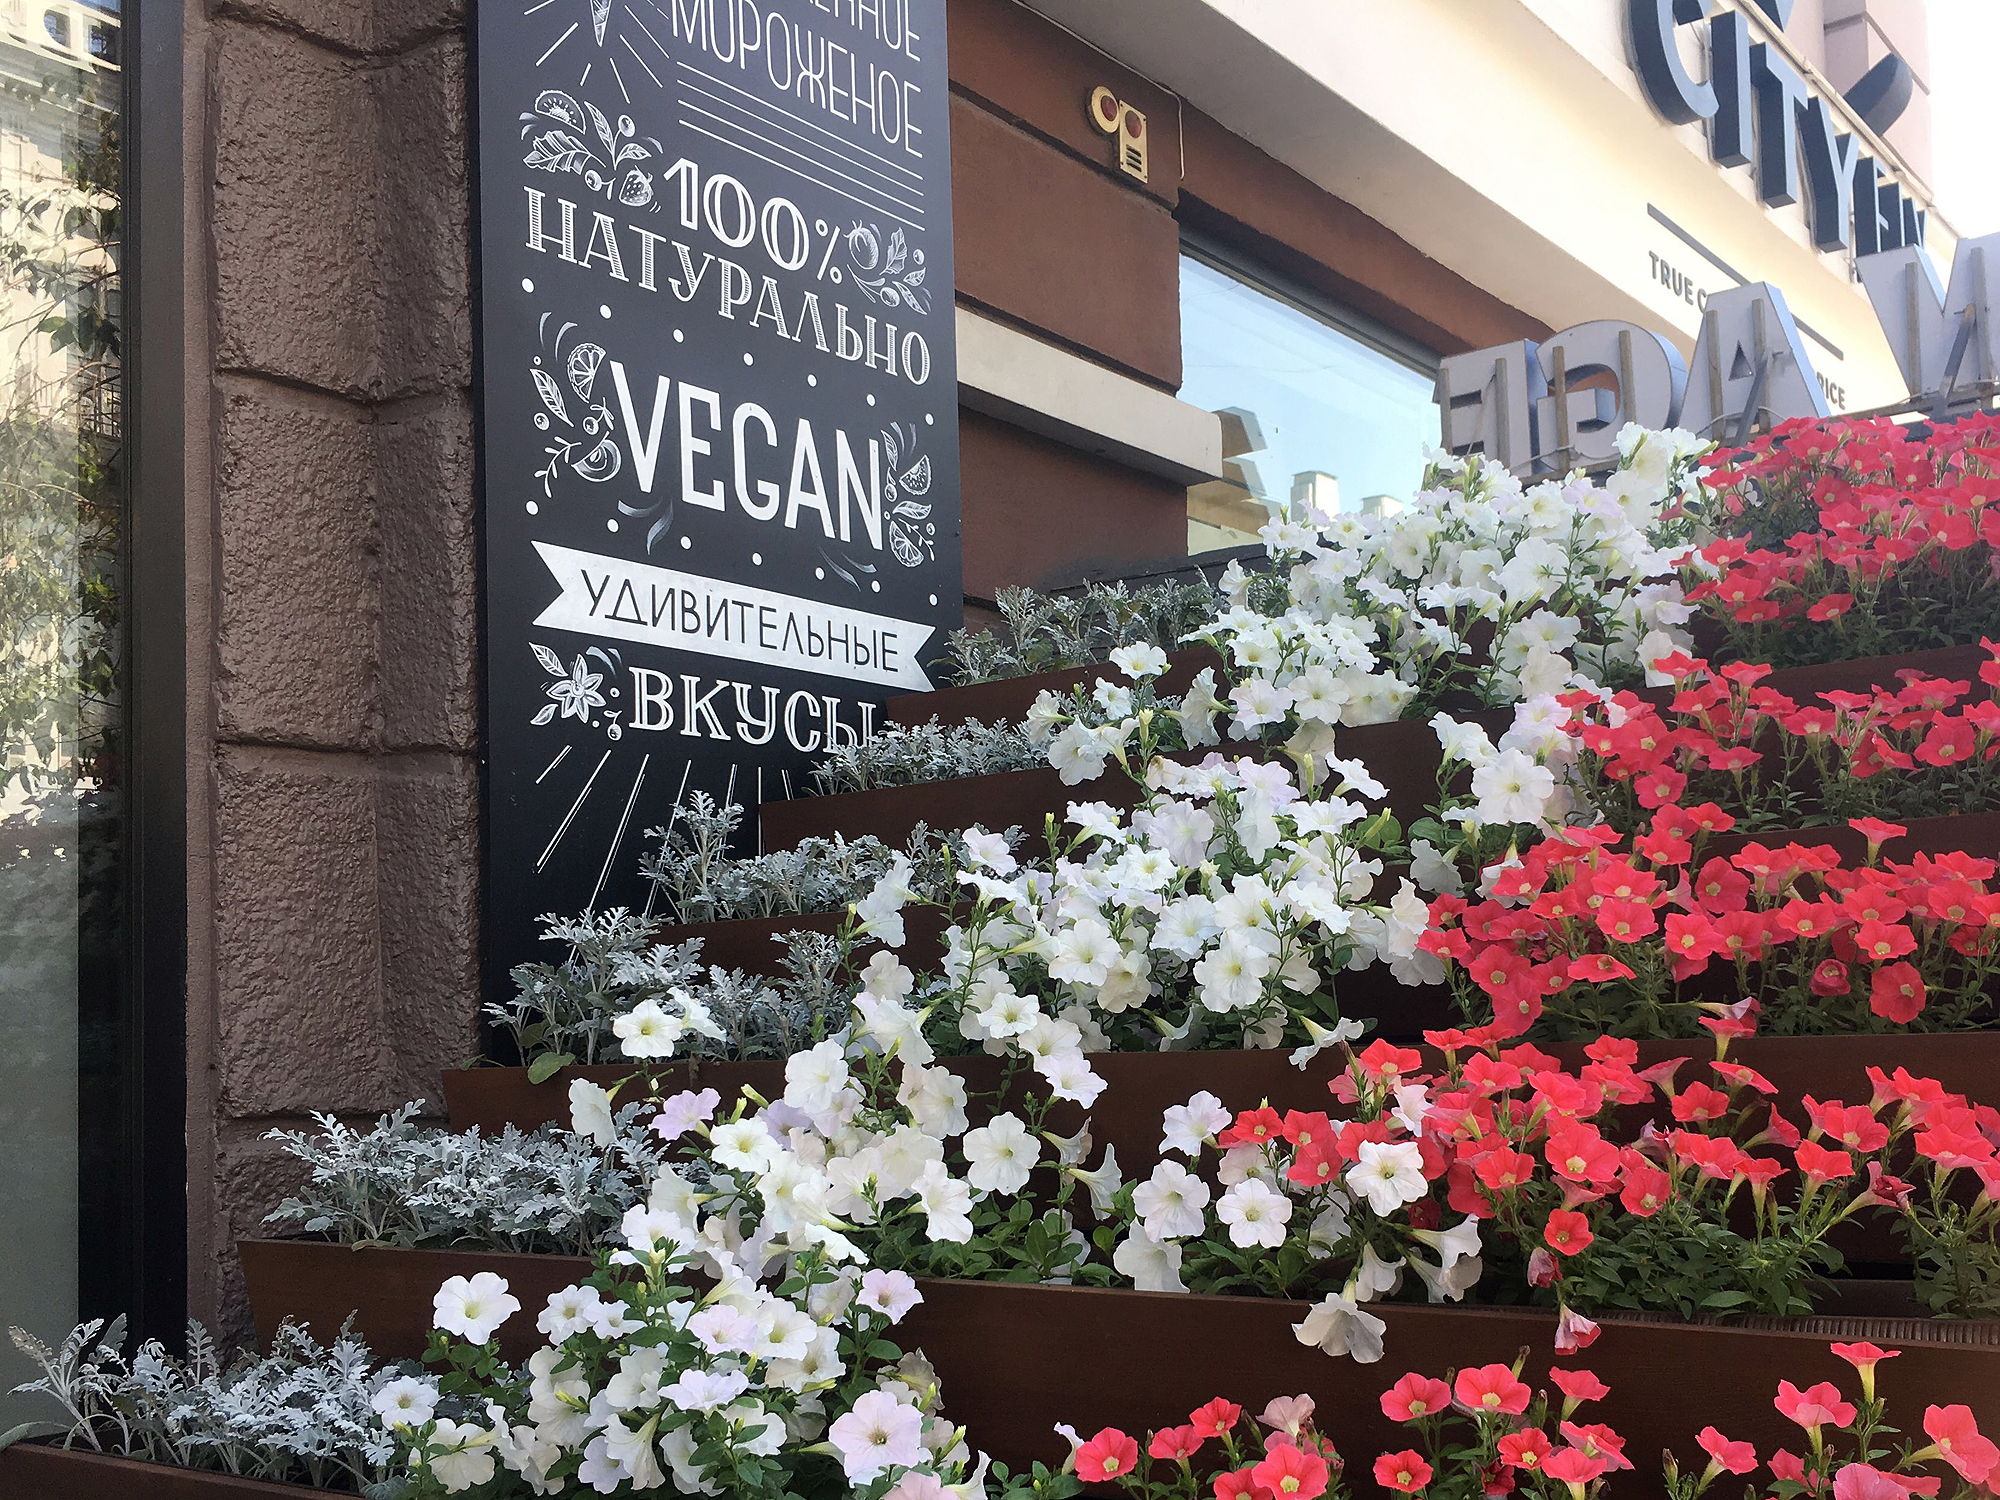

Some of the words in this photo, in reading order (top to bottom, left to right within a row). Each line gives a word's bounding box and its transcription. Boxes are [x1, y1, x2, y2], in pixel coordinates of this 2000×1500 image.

[664, 157, 843, 285] 100%
[1648, 250, 1695, 306] TRUE
[523, 185, 932, 386] НАТУРАЛЬНО
[609, 359, 884, 551] VEGAN
[580, 569, 899, 673] УДИВИТЕЛЬНЫЕ
[628, 666, 877, 754] ВКУСЫ
